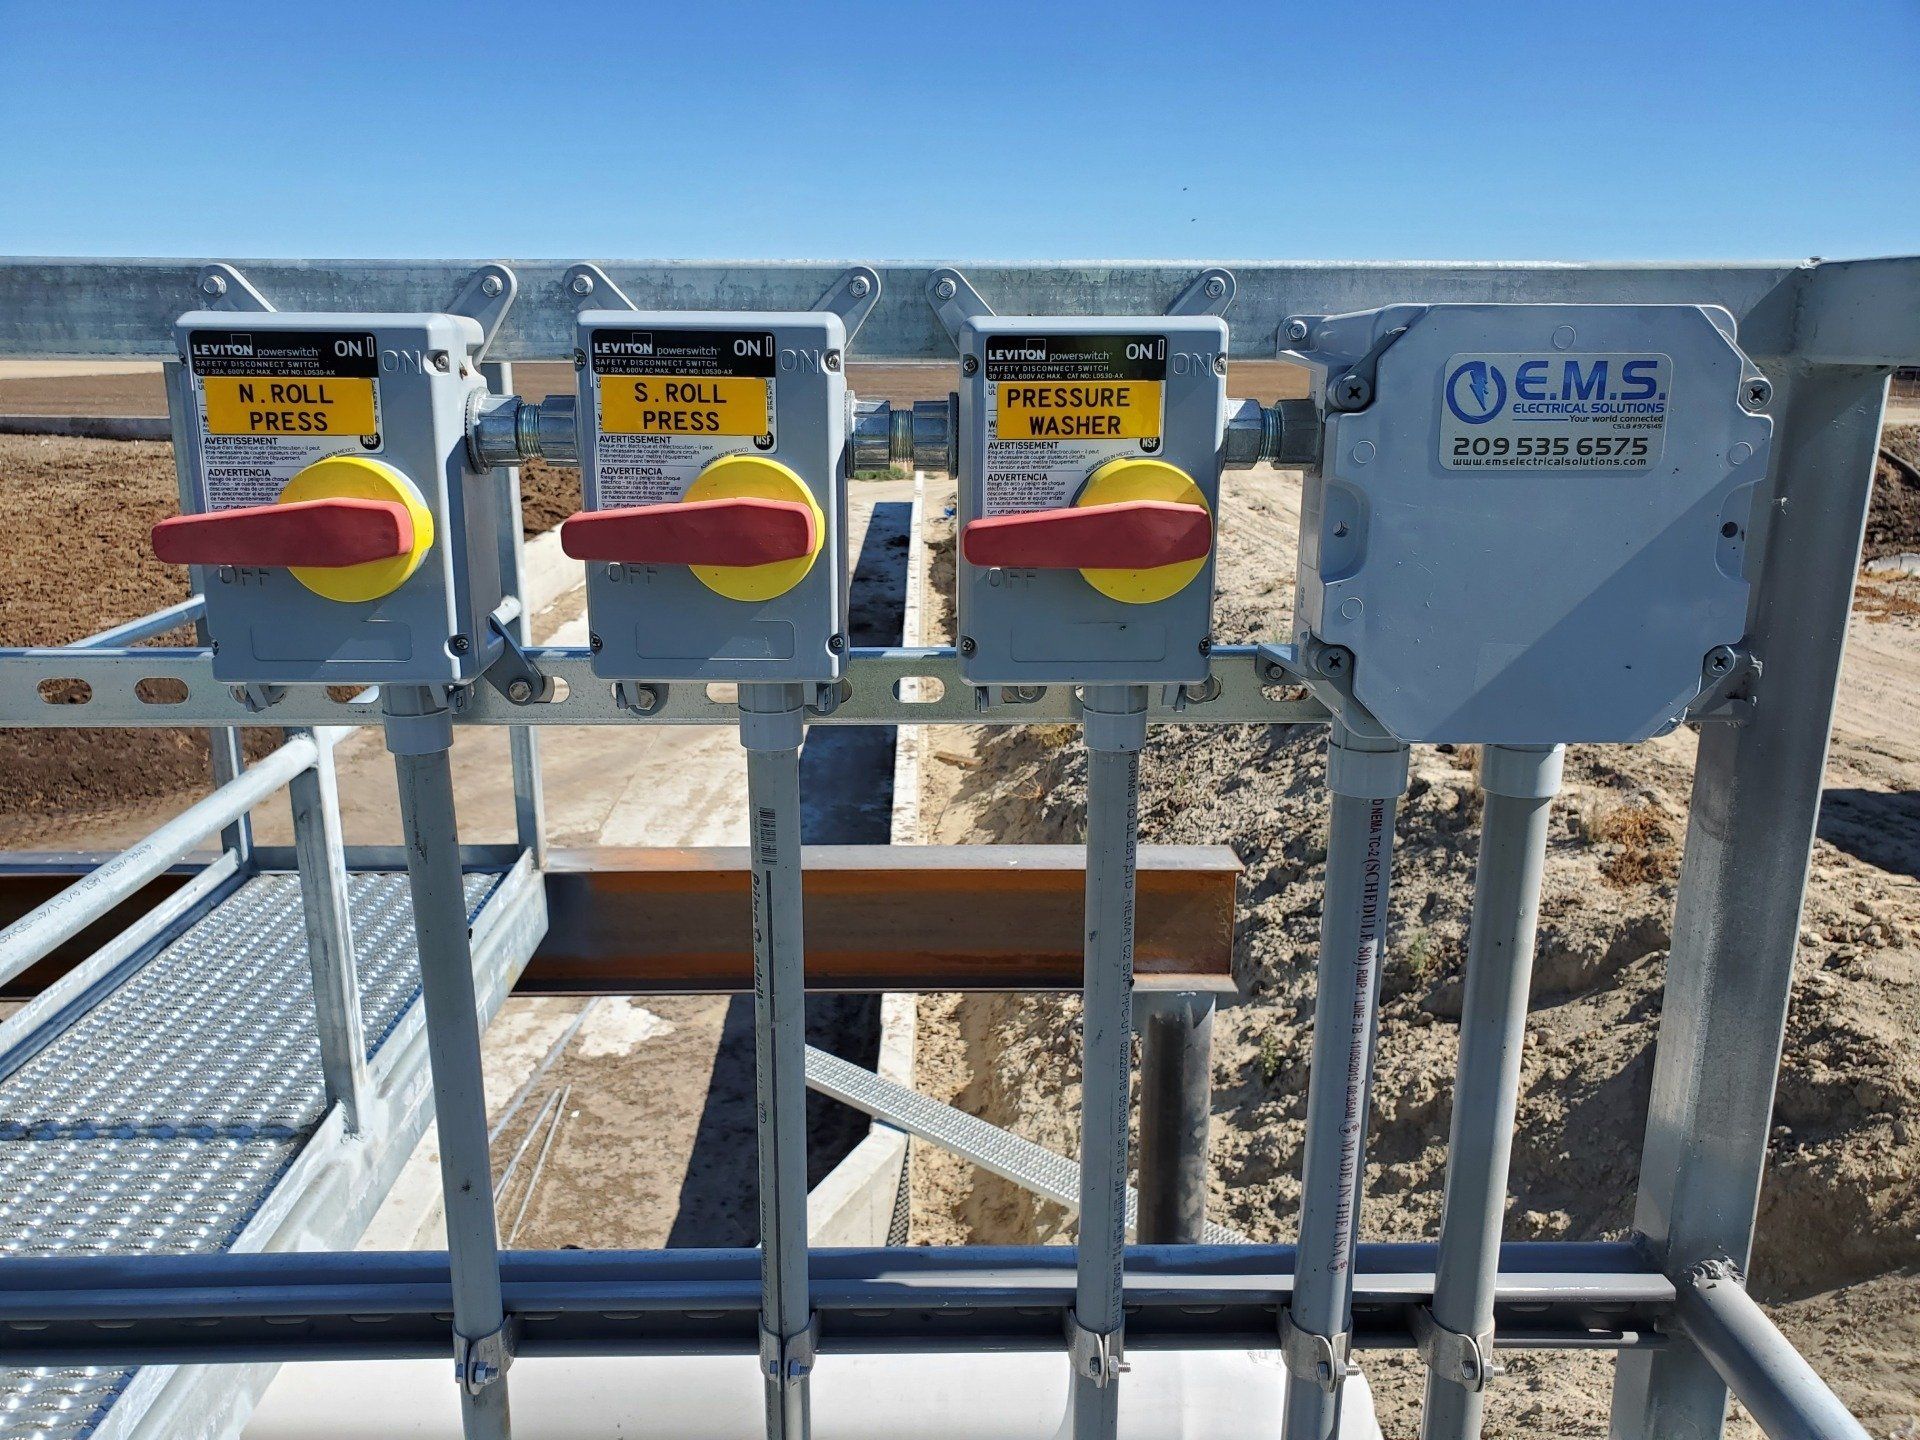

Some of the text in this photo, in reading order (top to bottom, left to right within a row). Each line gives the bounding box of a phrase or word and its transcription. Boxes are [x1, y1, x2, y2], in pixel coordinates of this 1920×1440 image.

[193, 341, 362, 358] LEVITON powerswitch ON
[594, 340, 761, 357] LEVITON powerswitch ON
[988, 343, 1152, 362] LEVITON powerswitch ON
[196, 360, 228, 368] SAFETY
[231, 360, 284, 368] DISCONNECT
[383, 350, 422, 375] ON
[630, 359, 683, 367] DISCONNECT
[781, 350, 818, 373] ON
[1173, 352, 1211, 377] ON
[196, 368, 205, 376] 30
[227, 368, 245, 376] 600V
[246, 368, 256, 376] AC
[278, 368, 290, 376] CAT
[1515, 360, 1666, 400] E.M.S.
[1007, 388, 1130, 408] PRESSURE
[1513, 403, 1665, 413] ELECTRICAL SOLUTIONS
[250, 412, 328, 431] PRESS
[643, 412, 720, 431] PRESS
[1029, 416, 1120, 435] WASHER
[1569, 415, 1590, 423] Your
[204, 437, 278, 445] AVERTISSEMENT
[362, 435, 379, 446] NSF
[599, 436, 672, 444] AVERTISSEMENT
[756, 435, 772, 446] NSF
[1141, 438, 1157, 448] NSF
[1453, 438, 1648, 455] 209 535 6575
[1453, 457, 1646, 466] www.emselectricalsolutions.com
[208, 468, 271, 476] ADVERTENCIA
[601, 468, 662, 476] ADVERTENCIA
[988, 473, 1048, 481] ADVERTENCIA
[1370, 808, 1382, 834] NEMA
[1368, 836, 1381, 856] TC-2
[1359, 859, 1381, 943] (SCHEDULE
[1353, 946, 1372, 966] 80)
[1356, 969, 1368, 988] RMP
[1353, 1000, 1365, 1019] LINE
[1338, 1139, 1356, 1181] MADE
[1338, 1184, 1352, 1198] IN
[1335, 1200, 1350, 1229] THE
[1332, 1231, 1348, 1258] USA
